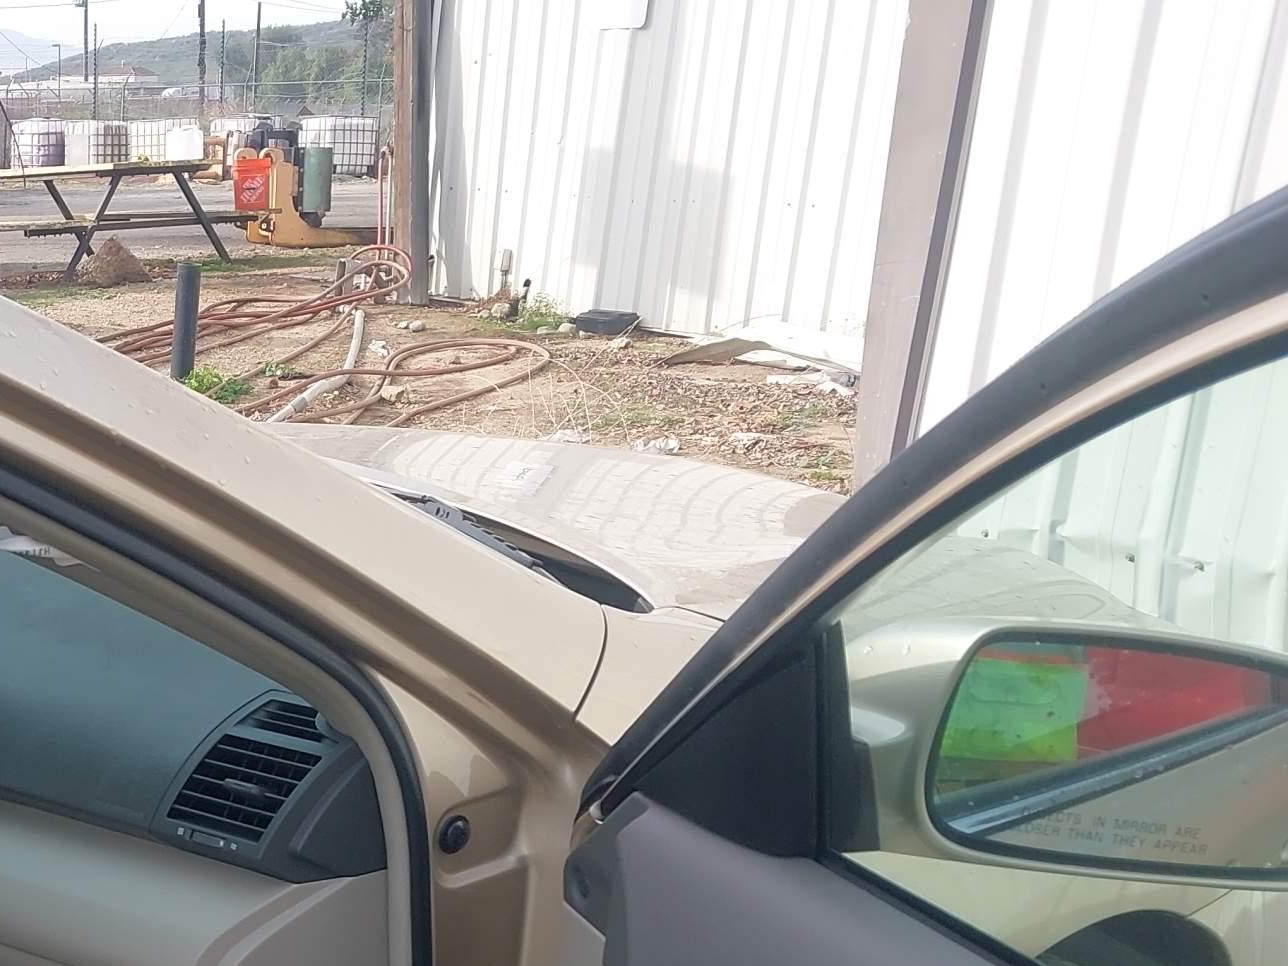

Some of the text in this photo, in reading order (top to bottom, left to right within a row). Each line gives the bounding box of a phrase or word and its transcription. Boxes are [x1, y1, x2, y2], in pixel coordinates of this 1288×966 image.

[1093, 815, 1106, 828] IN
[1114, 818, 1167, 834] MIRROR
[1175, 826, 1201, 839] ARE
[1068, 828, 1105, 843] THAN
[1112, 834, 1146, 848] THEY
[1154, 840, 1208, 855] APPEAR
